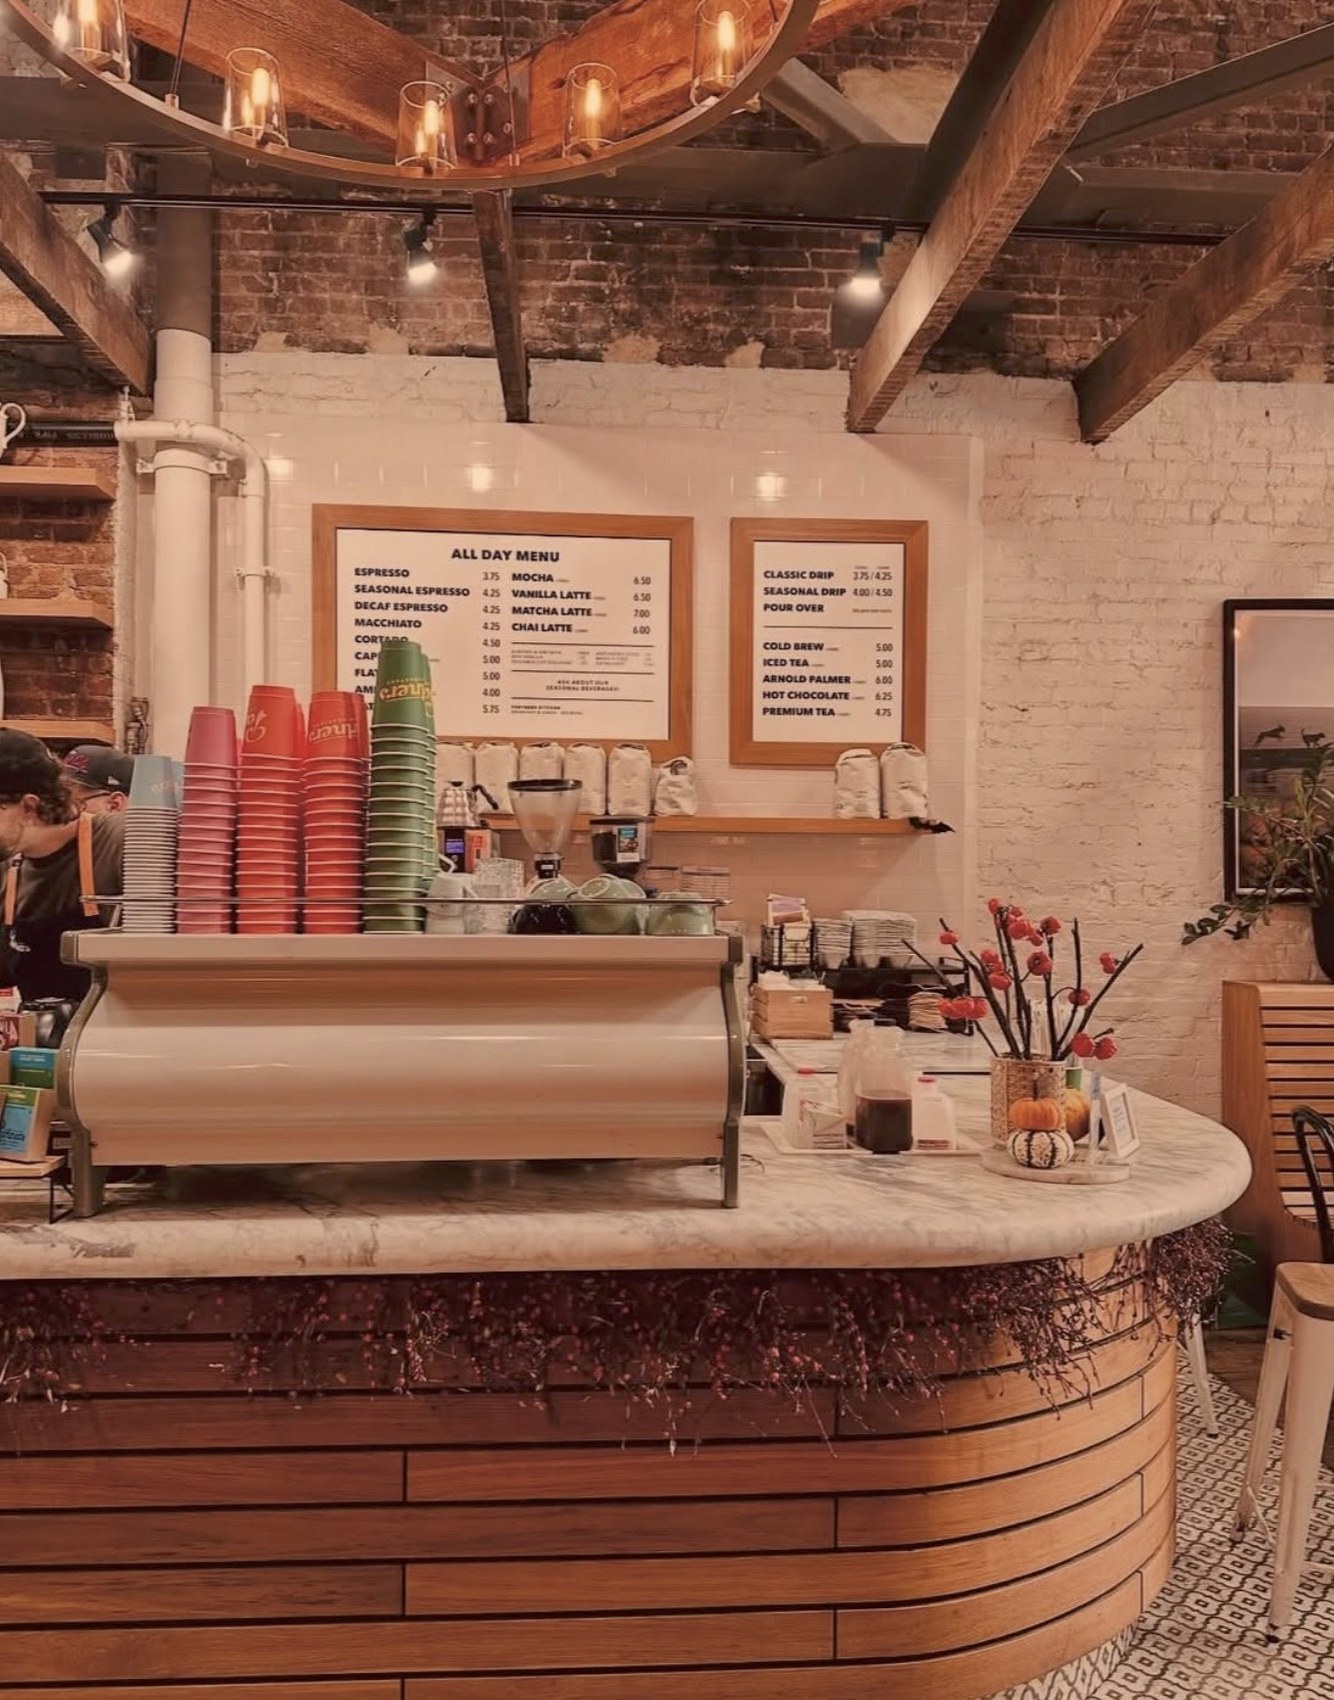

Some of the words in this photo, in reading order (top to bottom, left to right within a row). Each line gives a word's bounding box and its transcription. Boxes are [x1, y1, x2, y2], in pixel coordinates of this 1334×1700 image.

[451, 548, 479, 560] ALL
[481, 549, 513, 561] DAY
[515, 550, 560, 563] MENU
[354, 567, 410, 578] ESPRESSO
[482, 571, 501, 582] 3.75
[511, 572, 555, 583] MOCHA
[632, 576, 652, 586] 6.50
[763, 570, 807, 580] CLASSIC
[808, 570, 835, 580] DRIP
[354, 584, 414, 595] SEASONAL
[415, 586, 471, 597] ESPRESSO
[482, 588, 501, 598] 4.25
[511, 589, 558, 599] VANILLA
[559, 590, 592, 600] LATTE
[632, 592, 652, 602] 6.50
[763, 586, 820, 597] SEASONAL
[820, 587, 847, 597] DRIP
[354, 601, 391, 611] DECAF
[392, 602, 449, 613] ESPRESSO
[482, 604, 501, 615] 4.25
[511, 606, 560, 616] MATCHA
[560, 607, 593, 617] LATTE
[633, 608, 651, 619] 7.00
[763, 603, 795, 613] POUR
[795, 603, 825, 613] OVER
[354, 618, 423, 629] MACCHIATO
[482, 621, 501, 631] 4.25
[511, 622, 539, 632] CHAI
[540, 623, 573, 633] LATTE
[632, 625, 651, 635] 6.00
[482, 638, 501, 648] 4.50
[762, 641, 793, 651] COLD
[793, 642, 825, 651] BREW
[875, 642, 894, 653] 5.00
[482, 654, 501, 665] 5.00
[762, 658, 788, 667] ICED
[788, 658, 810, 668] TEA
[875, 659, 894, 669] 5.00
[482, 671, 501, 681] 5.00
[762, 674, 807, 684] ARNOLD
[808, 675, 852, 685] PALMER
[874, 675, 894, 685] 6.00
[482, 687, 501, 698] 4.00
[762, 690, 786, 700] HOT
[786, 691, 850, 701] CHOCOLATE
[874, 691, 893, 701] 6.25
[482, 704, 500, 714] 5.75
[762, 707, 814, 716] PREMIUM
[815, 707, 836, 717] TEA
[874, 708, 892, 717] 4.75
